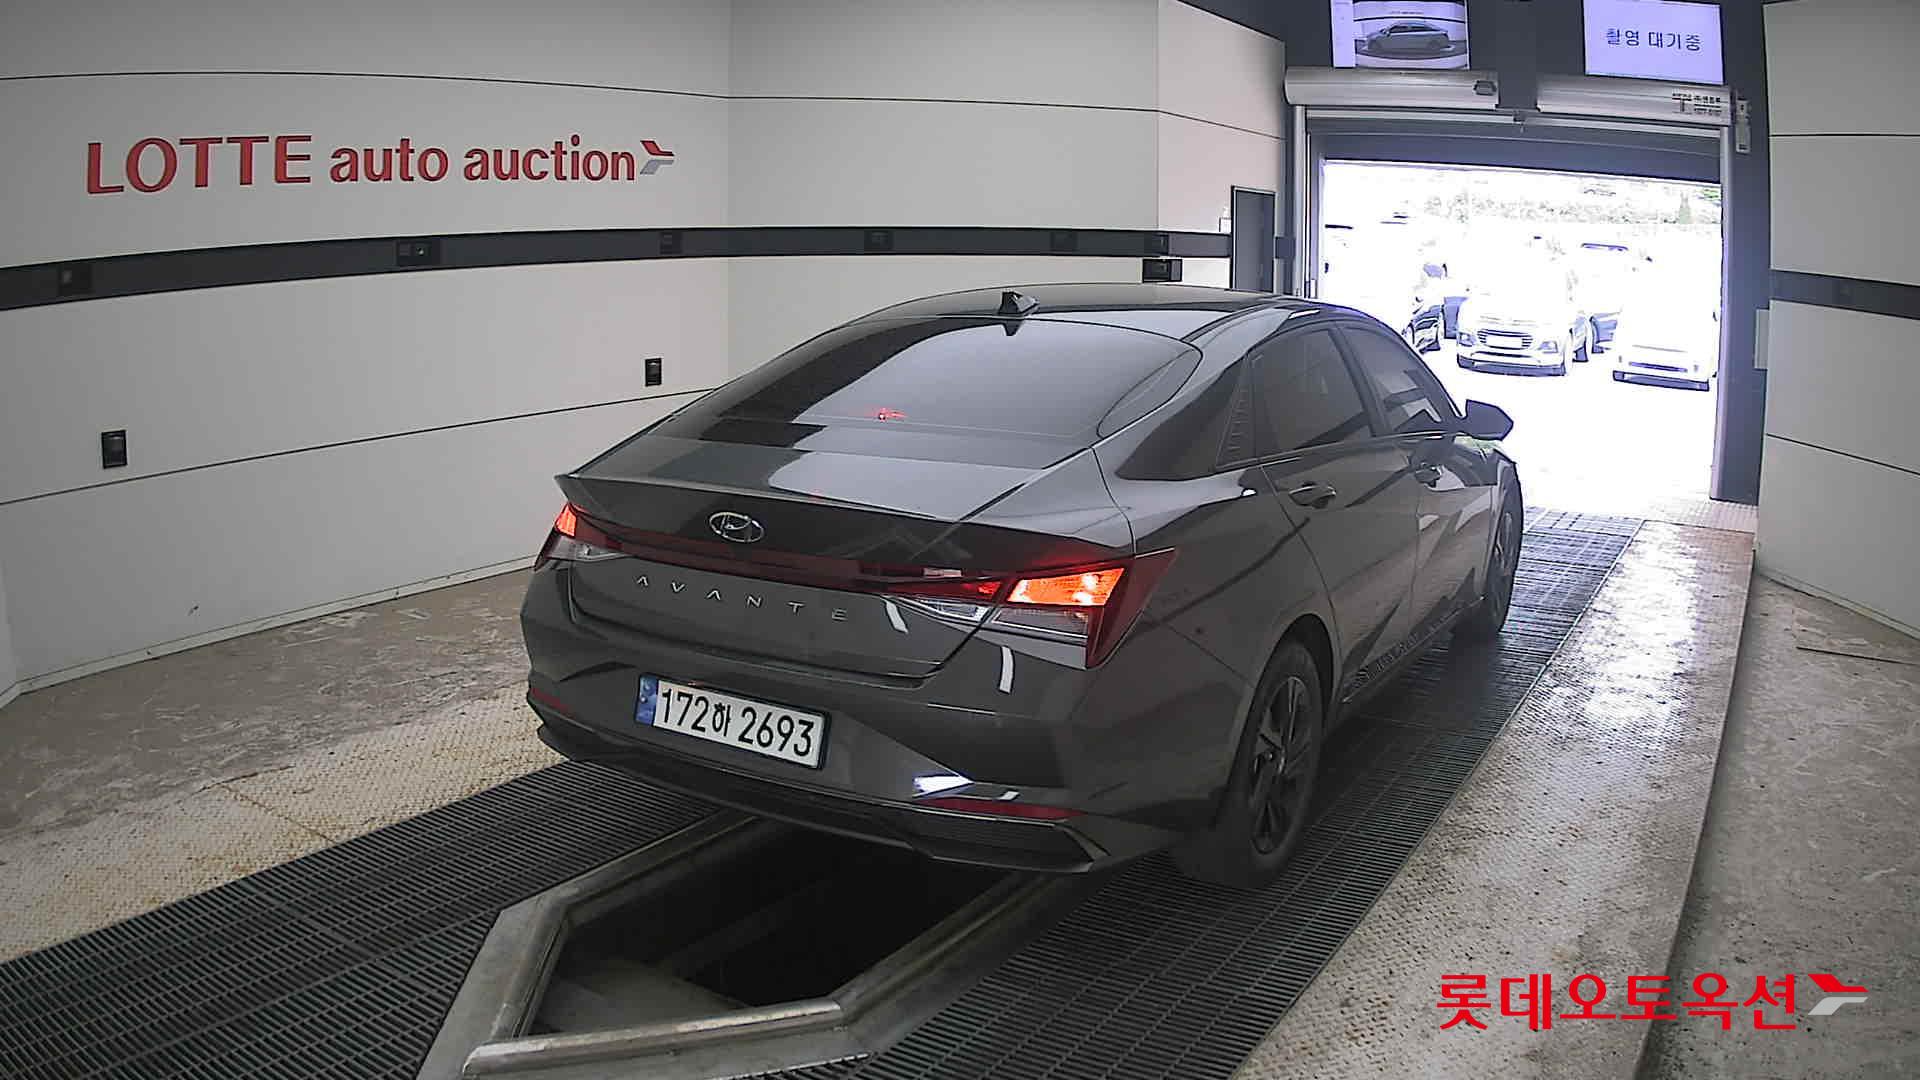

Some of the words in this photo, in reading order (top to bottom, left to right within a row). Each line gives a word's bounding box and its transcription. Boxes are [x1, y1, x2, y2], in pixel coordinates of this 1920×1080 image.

[1647, 31, 1701, 52] 대기중
[86, 134, 312, 194] LOTTE
[329, 138, 449, 182] auto
[463, 134, 636, 182] auction
[636, 575, 849, 622] AVANTE
[661, 687, 732, 738] 172하
[737, 706, 815, 757] 2693
